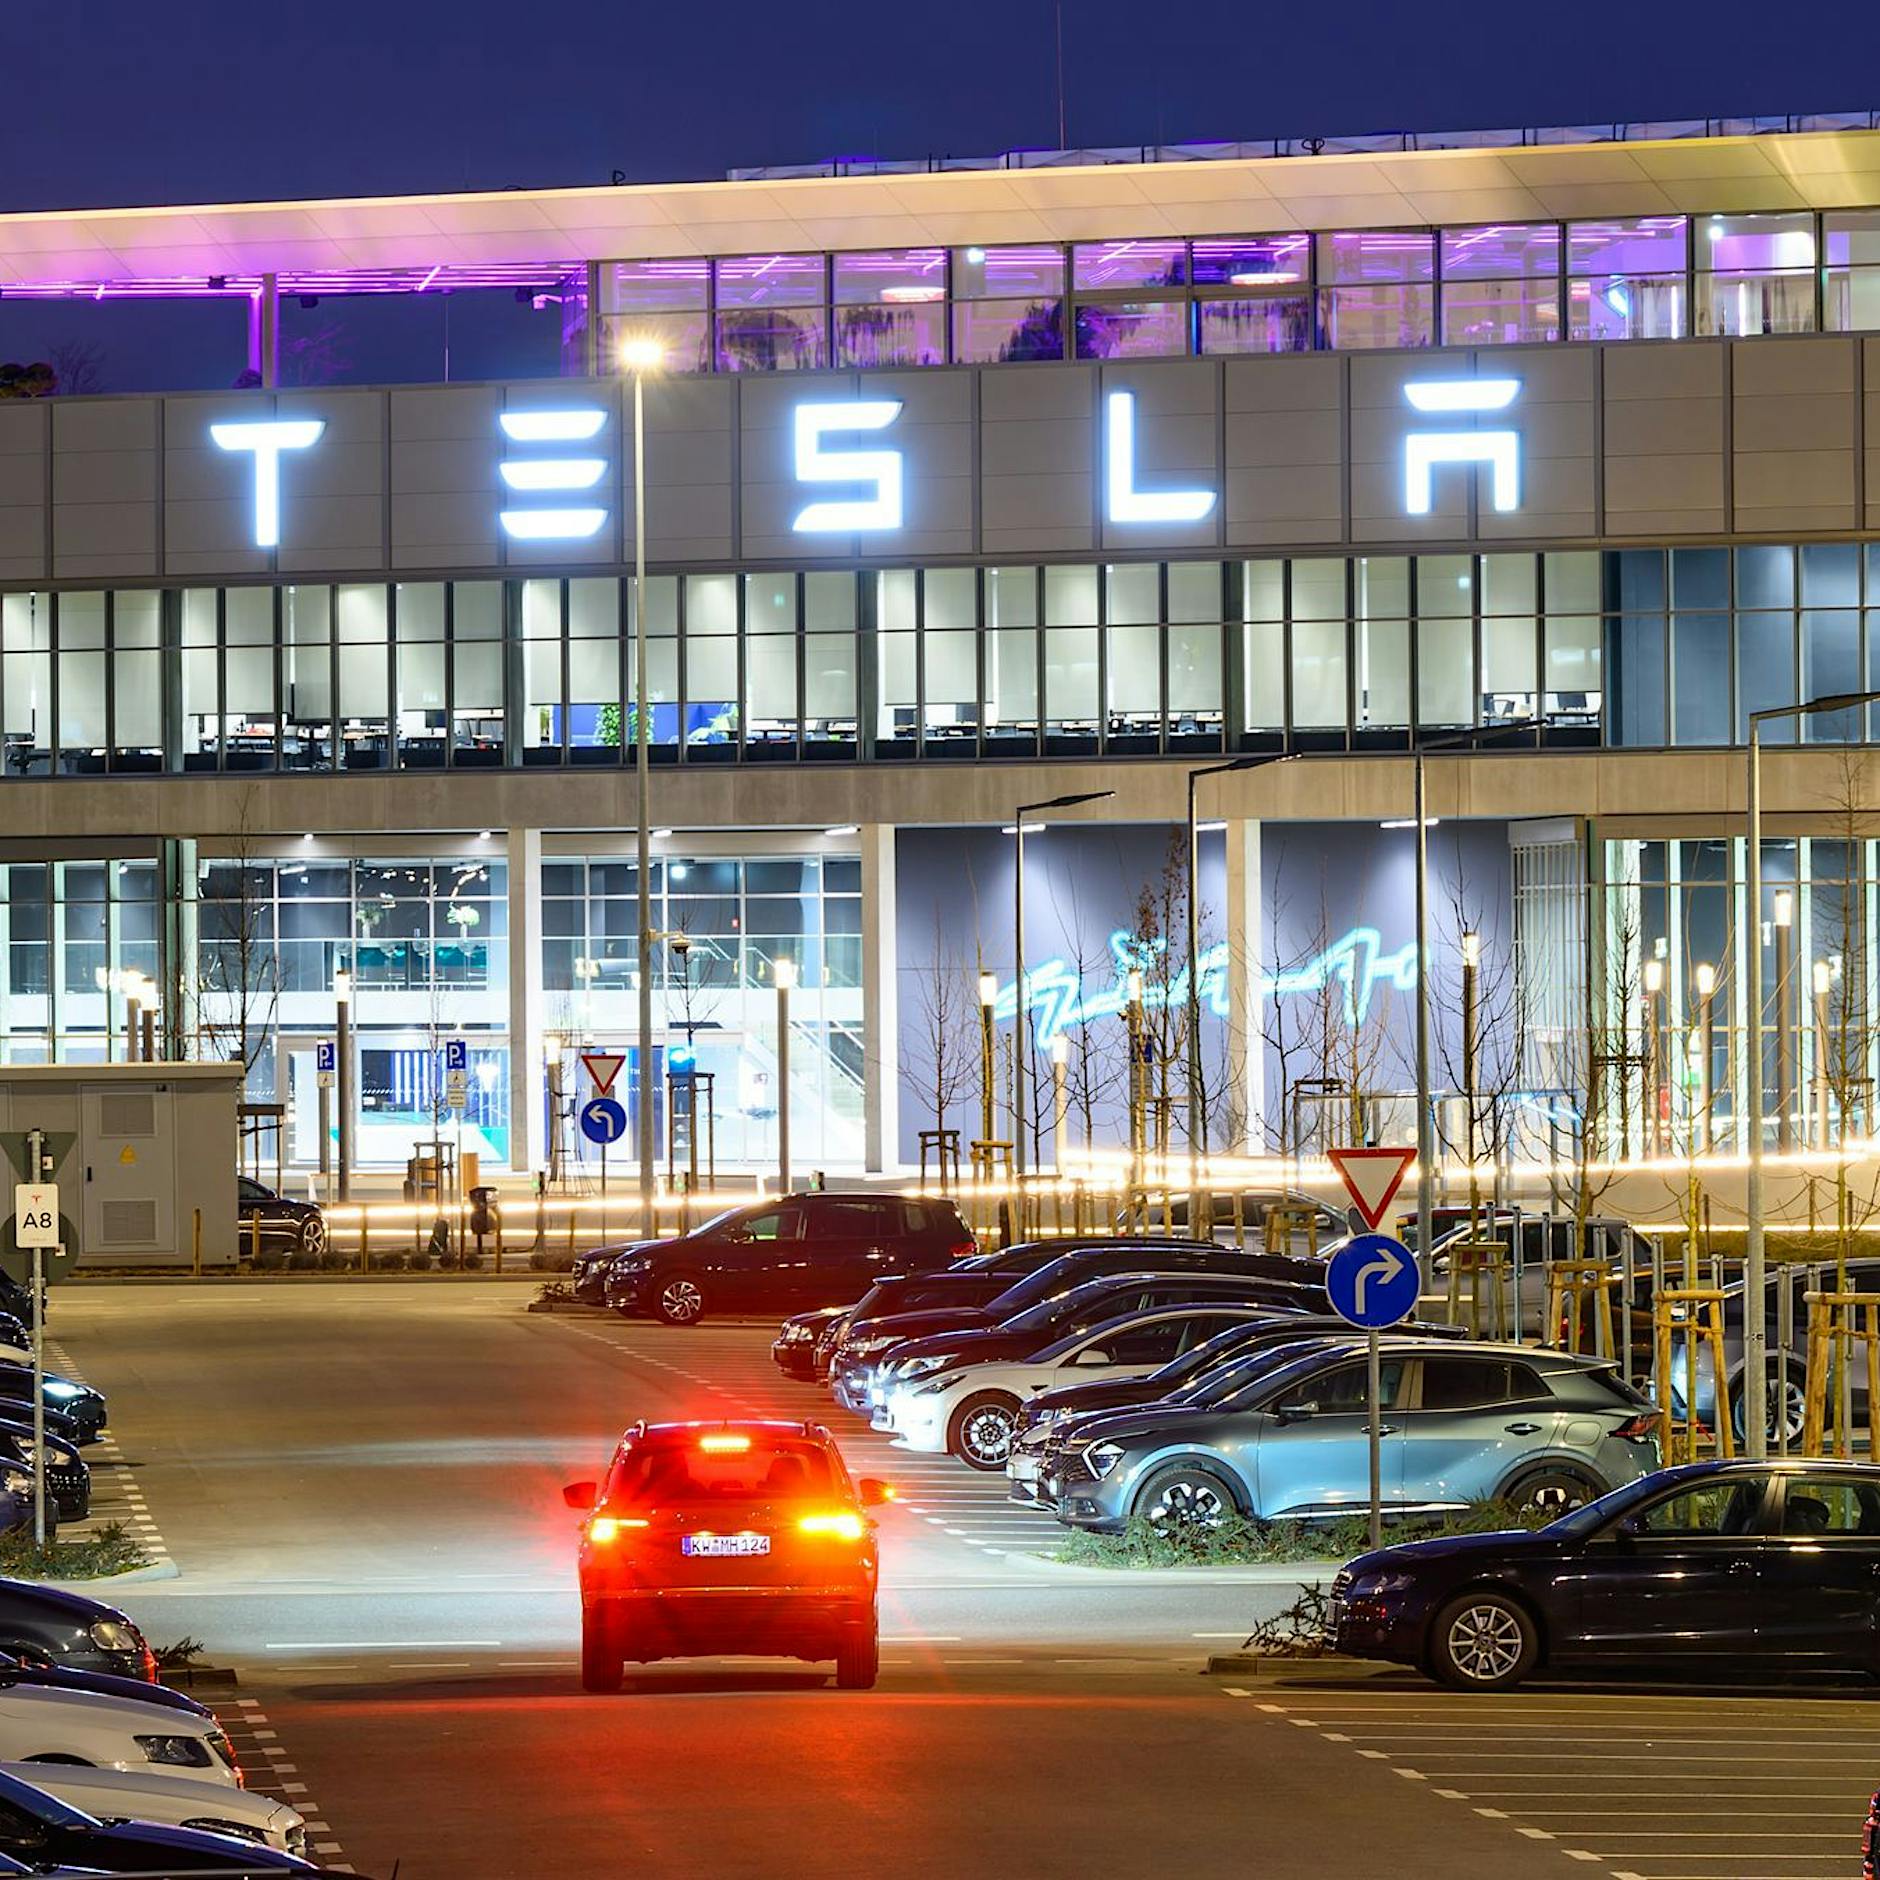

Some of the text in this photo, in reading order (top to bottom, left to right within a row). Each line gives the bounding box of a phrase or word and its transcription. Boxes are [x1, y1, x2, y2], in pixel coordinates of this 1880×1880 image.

[211, 380, 1517, 545] TESLA
[318, 1046, 331, 1067] P
[448, 1044, 461, 1066] P
[23, 1212, 52, 1229] A8
[741, 1538, 768, 1552] 124
